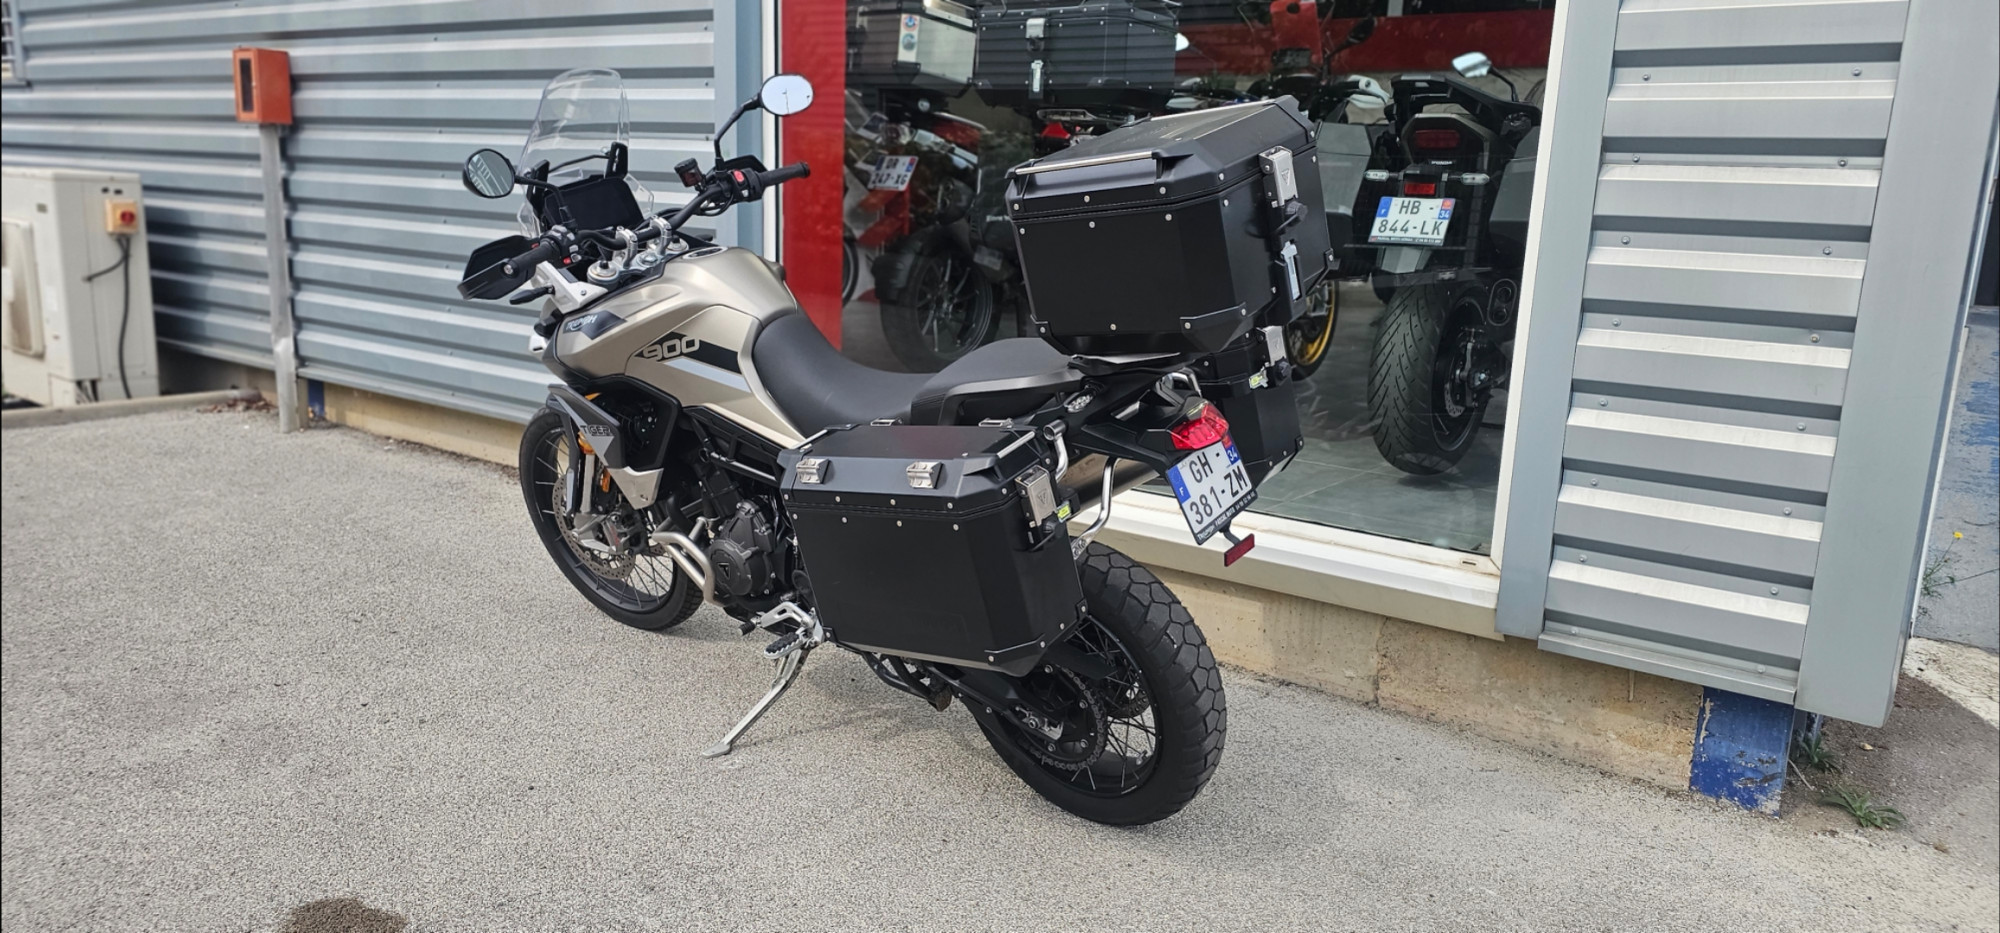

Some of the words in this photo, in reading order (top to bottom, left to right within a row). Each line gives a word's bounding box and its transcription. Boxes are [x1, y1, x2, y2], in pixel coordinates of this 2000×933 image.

[1399, 200, 1421, 215] HB
[1440, 210, 1450, 218] 34
[1378, 219, 1444, 236] 844-LK
[565, 313, 599, 331] TRIUMPH
[643, 336, 700, 360] 900
[580, 424, 611, 436] TIGER
[1228, 447, 1238, 462] 34
[1189, 451, 1213, 483] GH
[1190, 465, 1248, 525] 381-ZM
